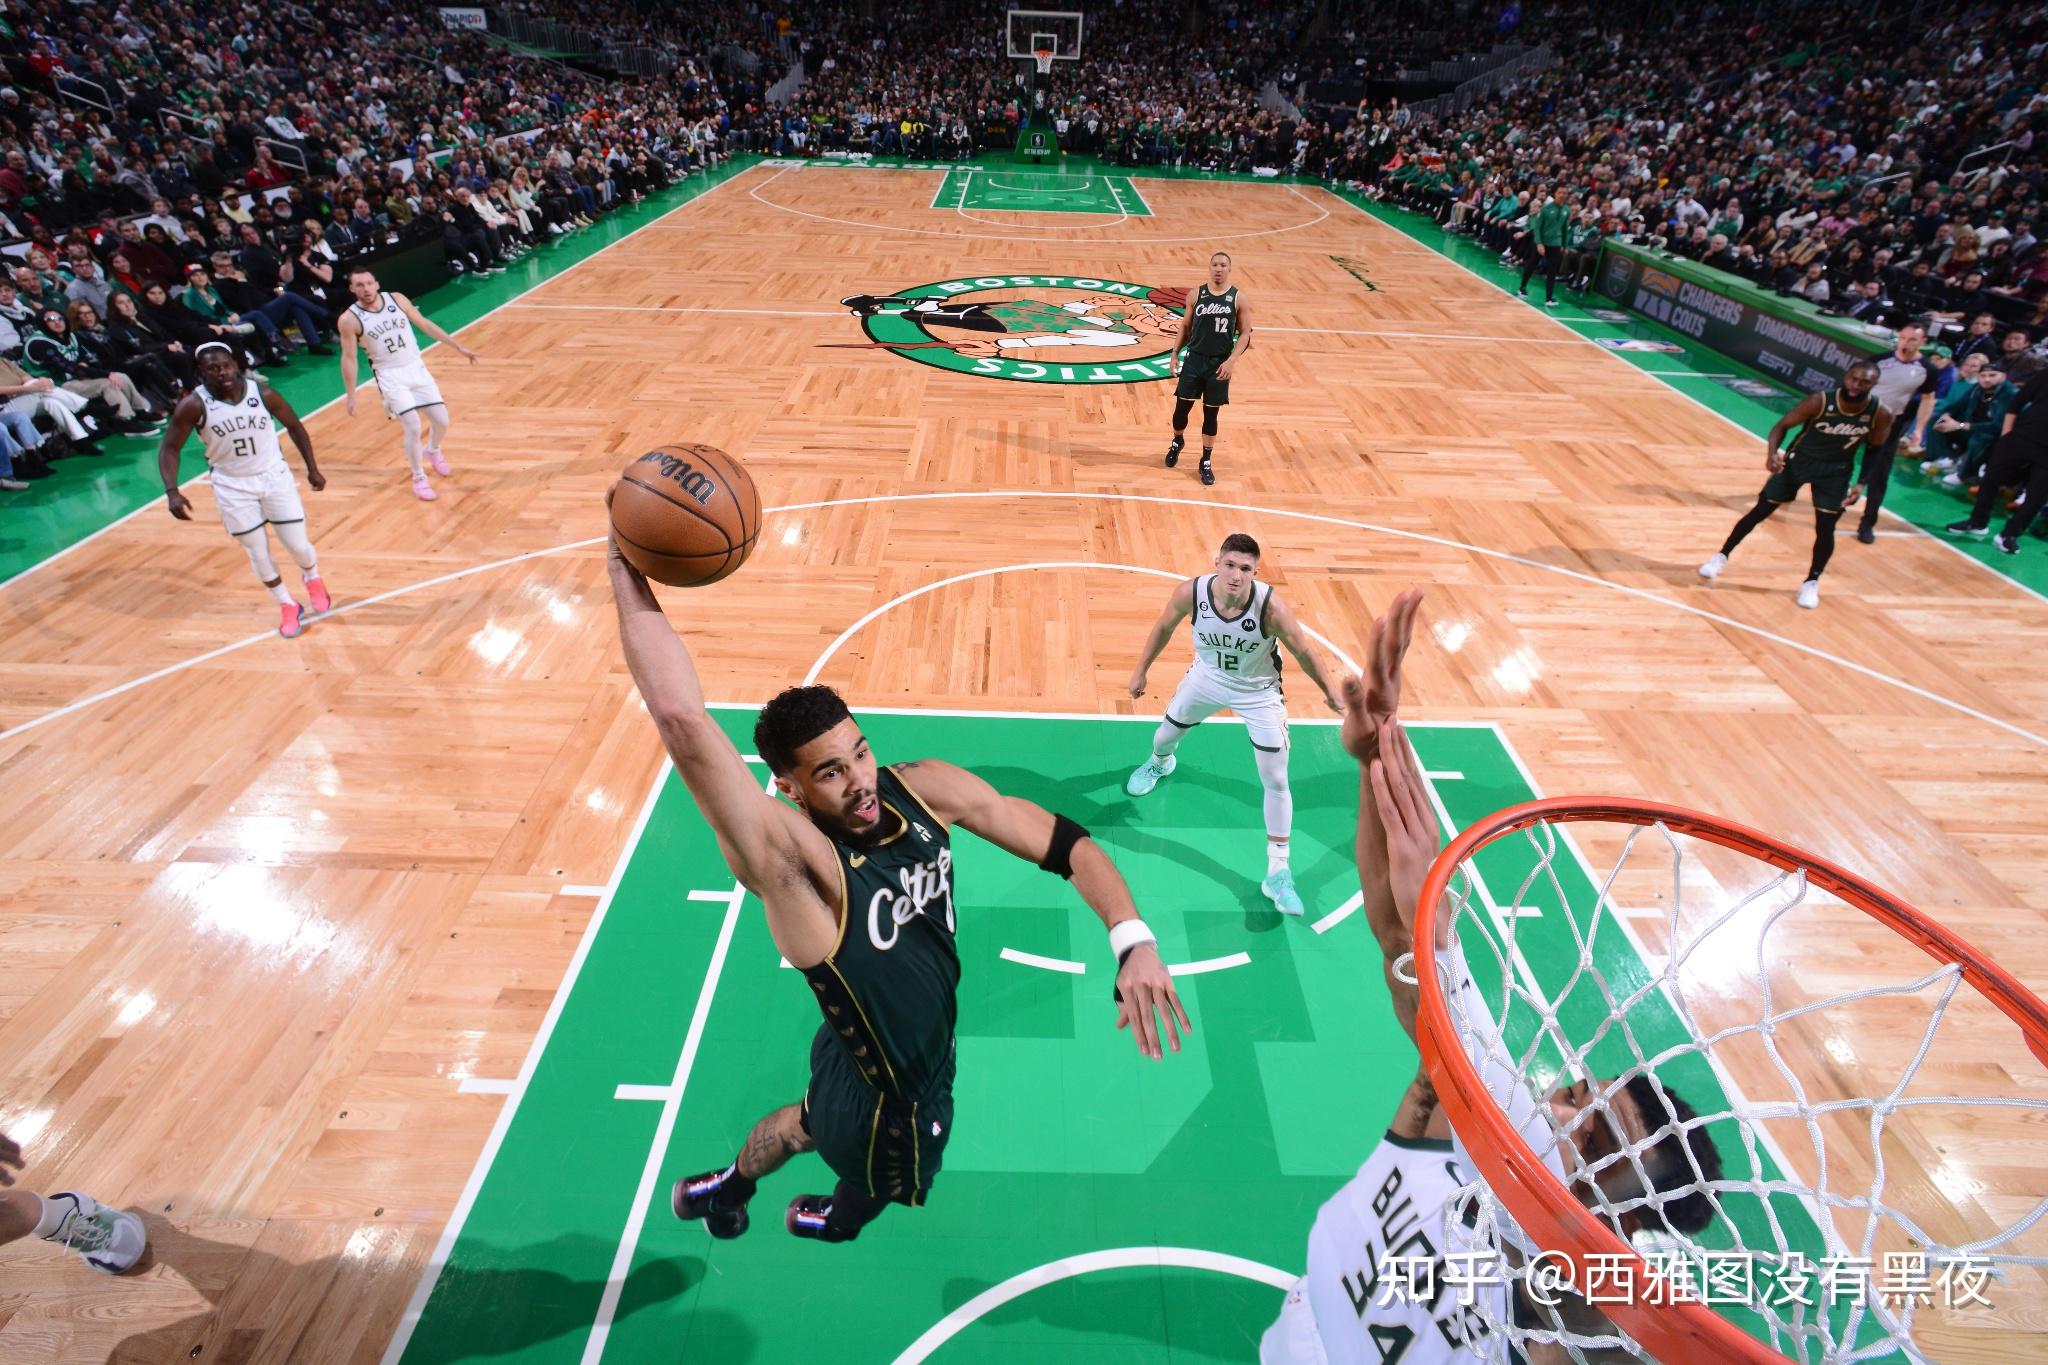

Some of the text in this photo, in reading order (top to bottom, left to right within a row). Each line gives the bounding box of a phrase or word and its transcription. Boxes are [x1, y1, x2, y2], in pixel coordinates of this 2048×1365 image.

[936, 276, 1141, 295] BOSTON
[1195, 303, 1231, 316] Celtics
[1679, 282, 1743, 325] CHARGERS
[367, 318, 406, 340] BUCKS
[1214, 317, 1229, 333] 12
[1671, 306, 1707, 338] COLTS
[384, 334, 406, 354] 24
[1754, 314, 1827, 358] TOMORROW
[1757, 350, 1795, 376] ESPN
[211, 415, 267, 438] BUCKS
[233, 437, 257, 457] 21
[1843, 436, 1860, 450] 7
[1198, 632, 1260, 654] BUCKS
[1216, 650, 1239, 671] 12
